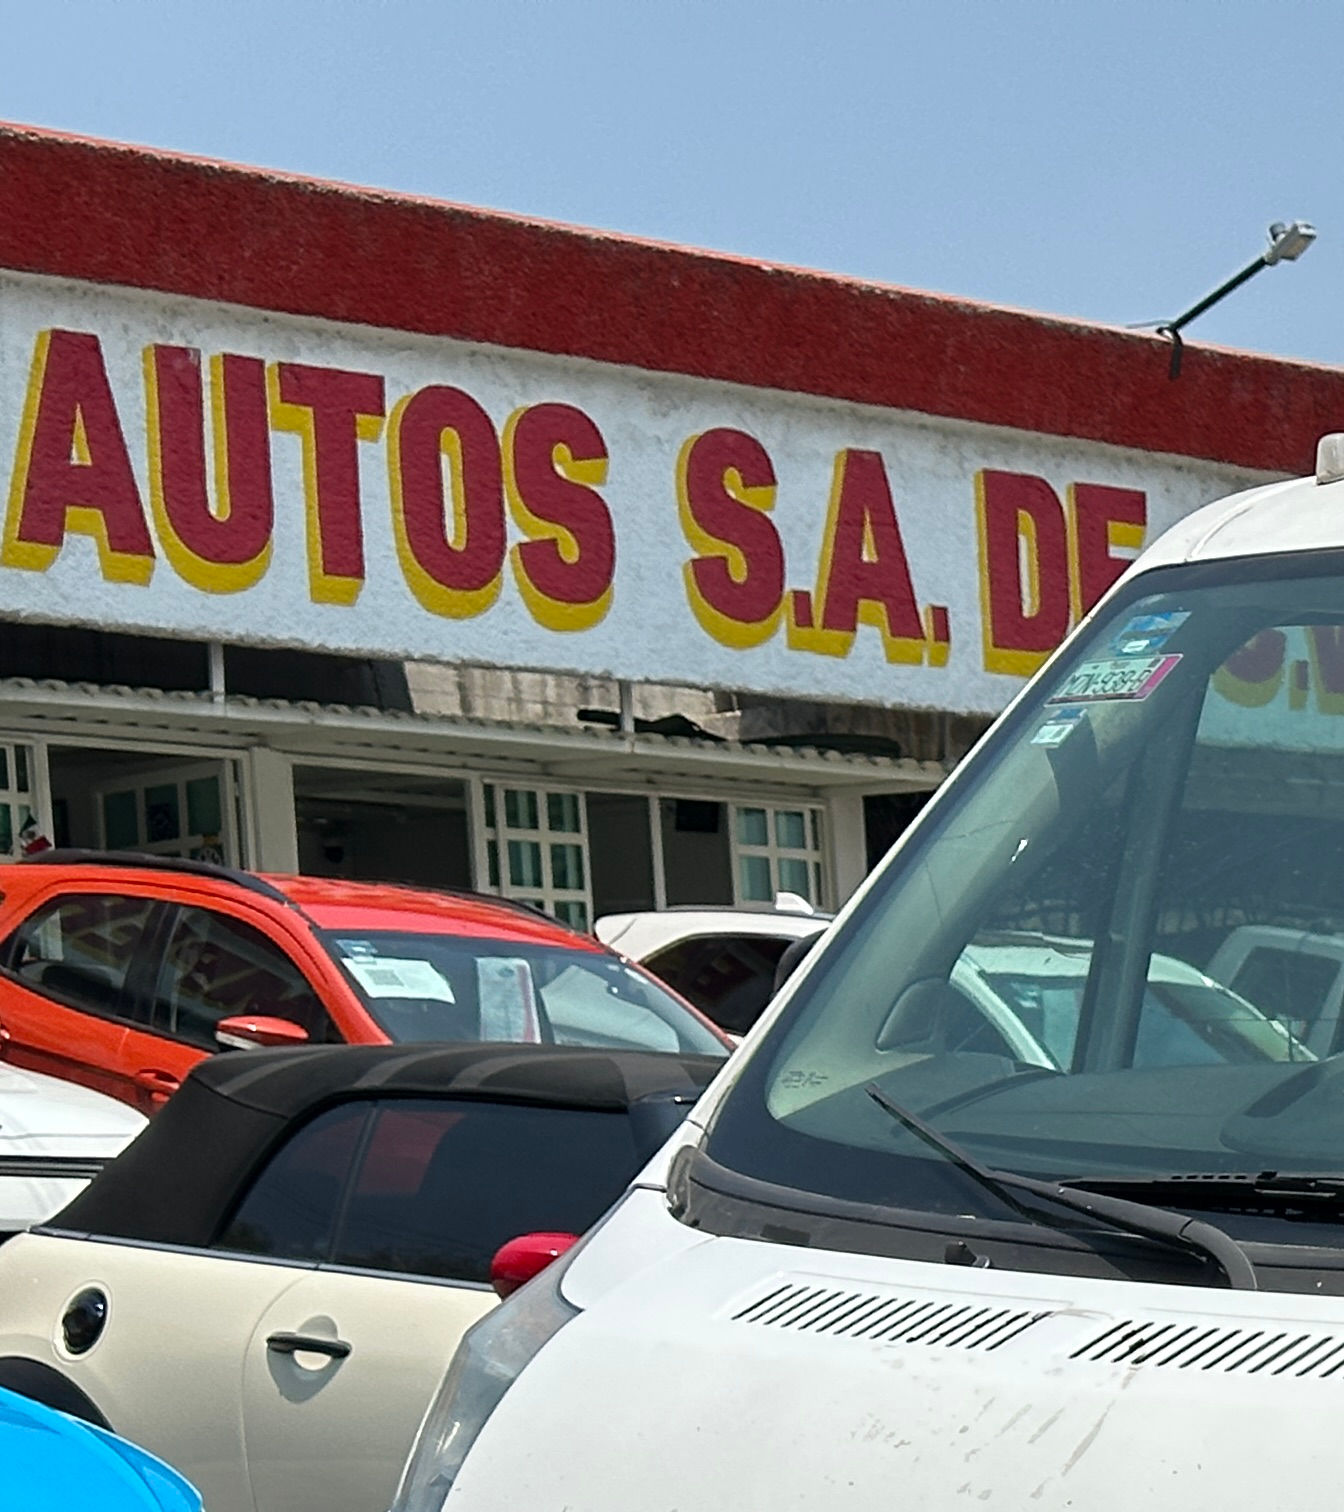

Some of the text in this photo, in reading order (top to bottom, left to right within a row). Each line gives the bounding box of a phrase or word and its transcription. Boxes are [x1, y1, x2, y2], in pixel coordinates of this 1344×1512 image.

[0, 328, 616, 633] AUTOS
[676, 427, 950, 668] S.A.
[975, 467, 1148, 676] DE
